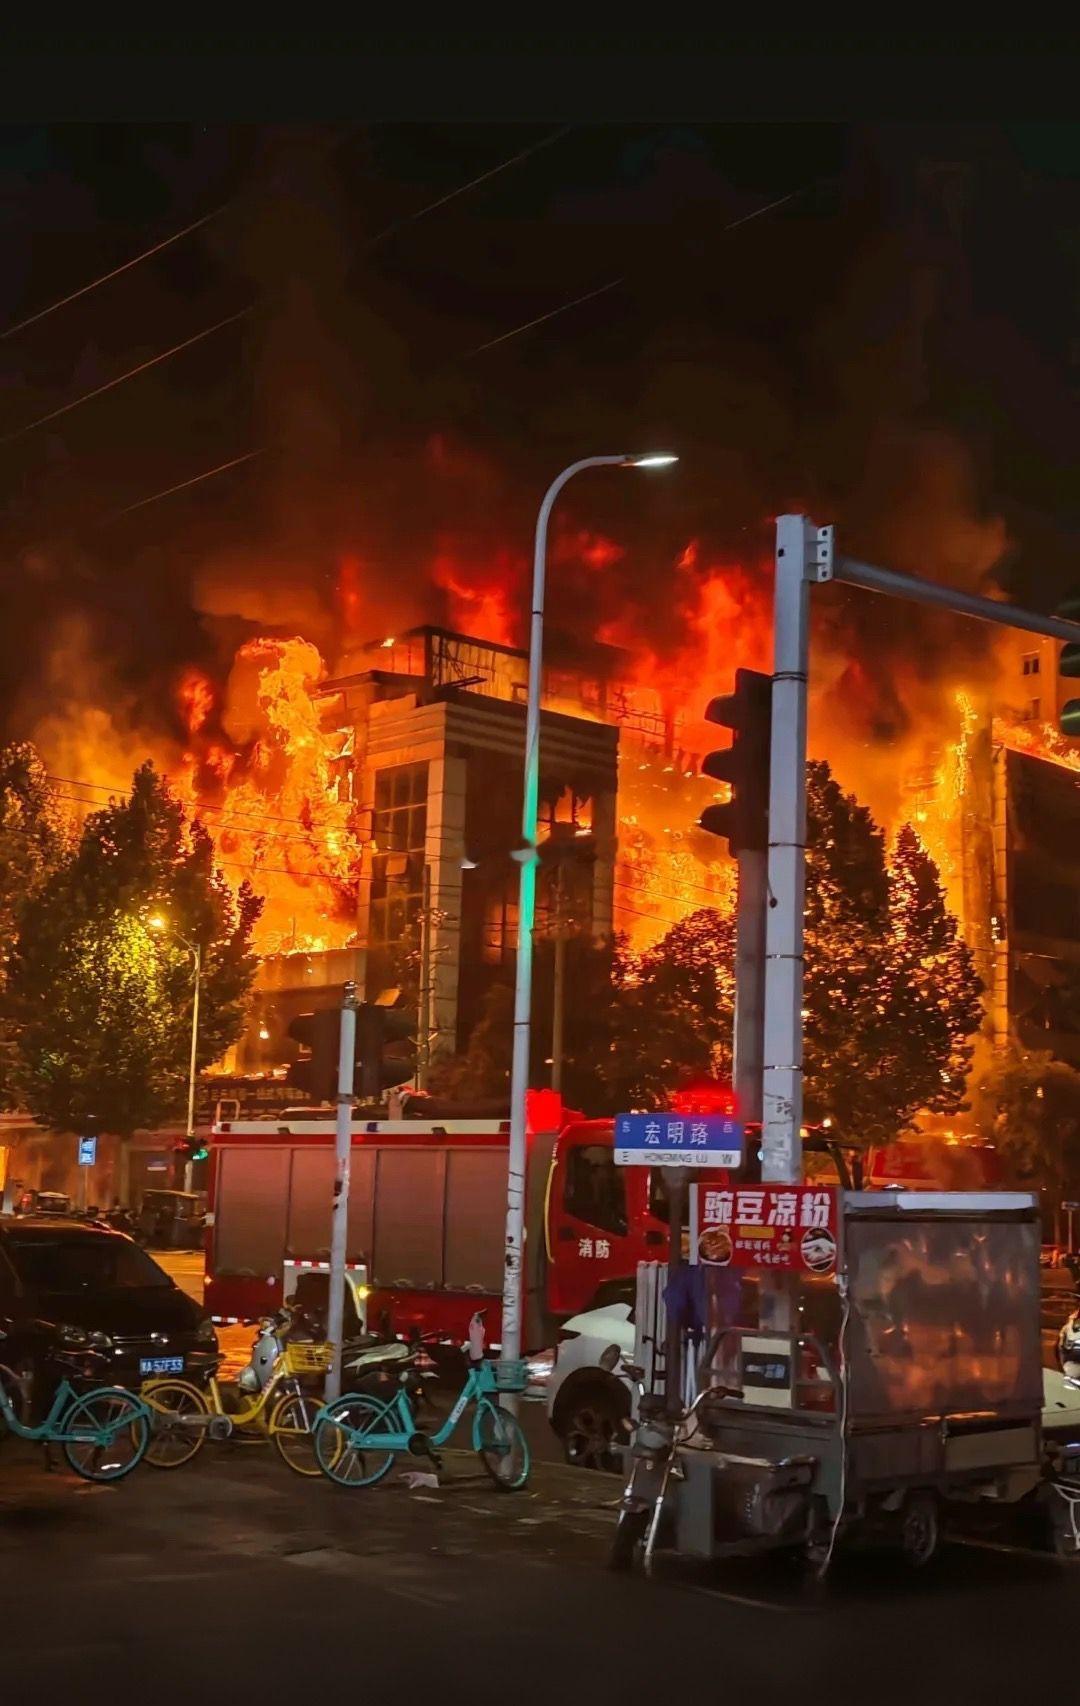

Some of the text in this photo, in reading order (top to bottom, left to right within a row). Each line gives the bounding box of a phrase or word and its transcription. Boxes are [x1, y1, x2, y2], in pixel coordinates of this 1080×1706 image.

[644, 1121, 708, 1145] 宏明路
[703, 1190, 831, 1227] 豌豆凉粉
[578, 1238, 610, 1259] 消防
